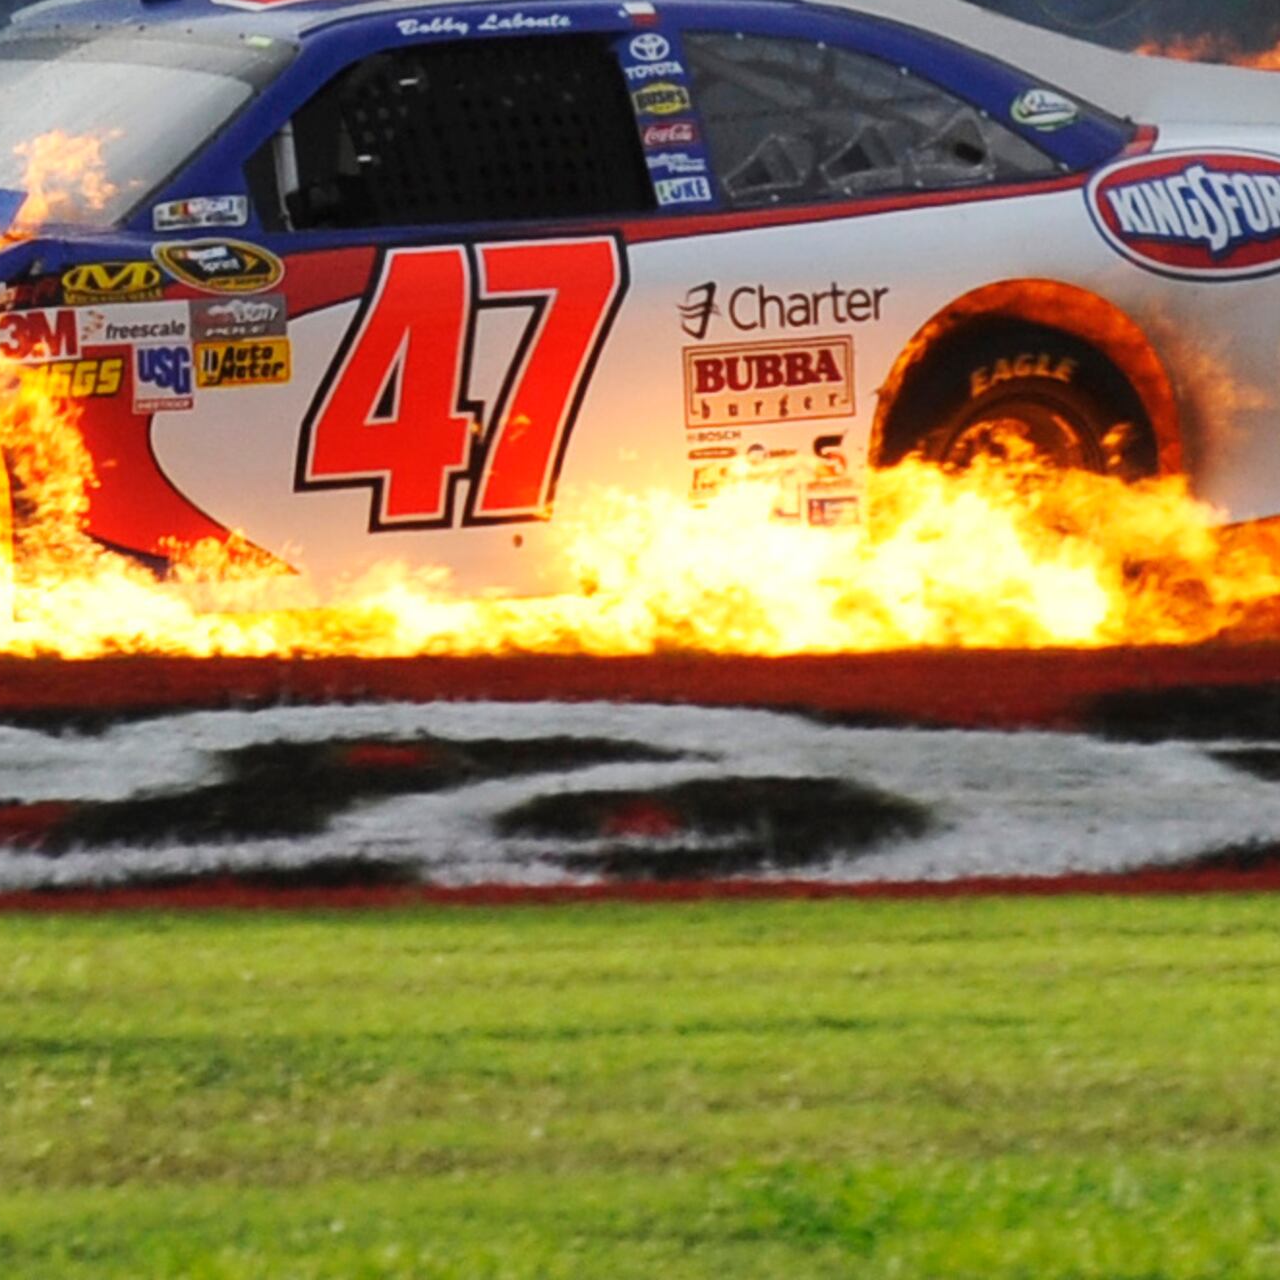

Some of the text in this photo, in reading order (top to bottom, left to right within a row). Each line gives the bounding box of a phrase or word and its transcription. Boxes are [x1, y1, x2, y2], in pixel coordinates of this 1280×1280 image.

[396, 12, 572, 37] Bobby Labonte
[624, 60, 685, 80] TOYOTA
[728, 281, 890, 332] Charter
[106, 320, 187, 339] freescale
[223, 346, 274, 363] Auto
[25, 358, 123, 398] EGS
[137, 346, 192, 395] USG
[219, 362, 284, 379] Meter
[293, 231, 630, 533] 47
[693, 349, 843, 394] BUBBA
[970, 353, 1079, 398] EAGLE
[700, 393, 838, 420] burger
[697, 430, 742, 443] BOSCH
